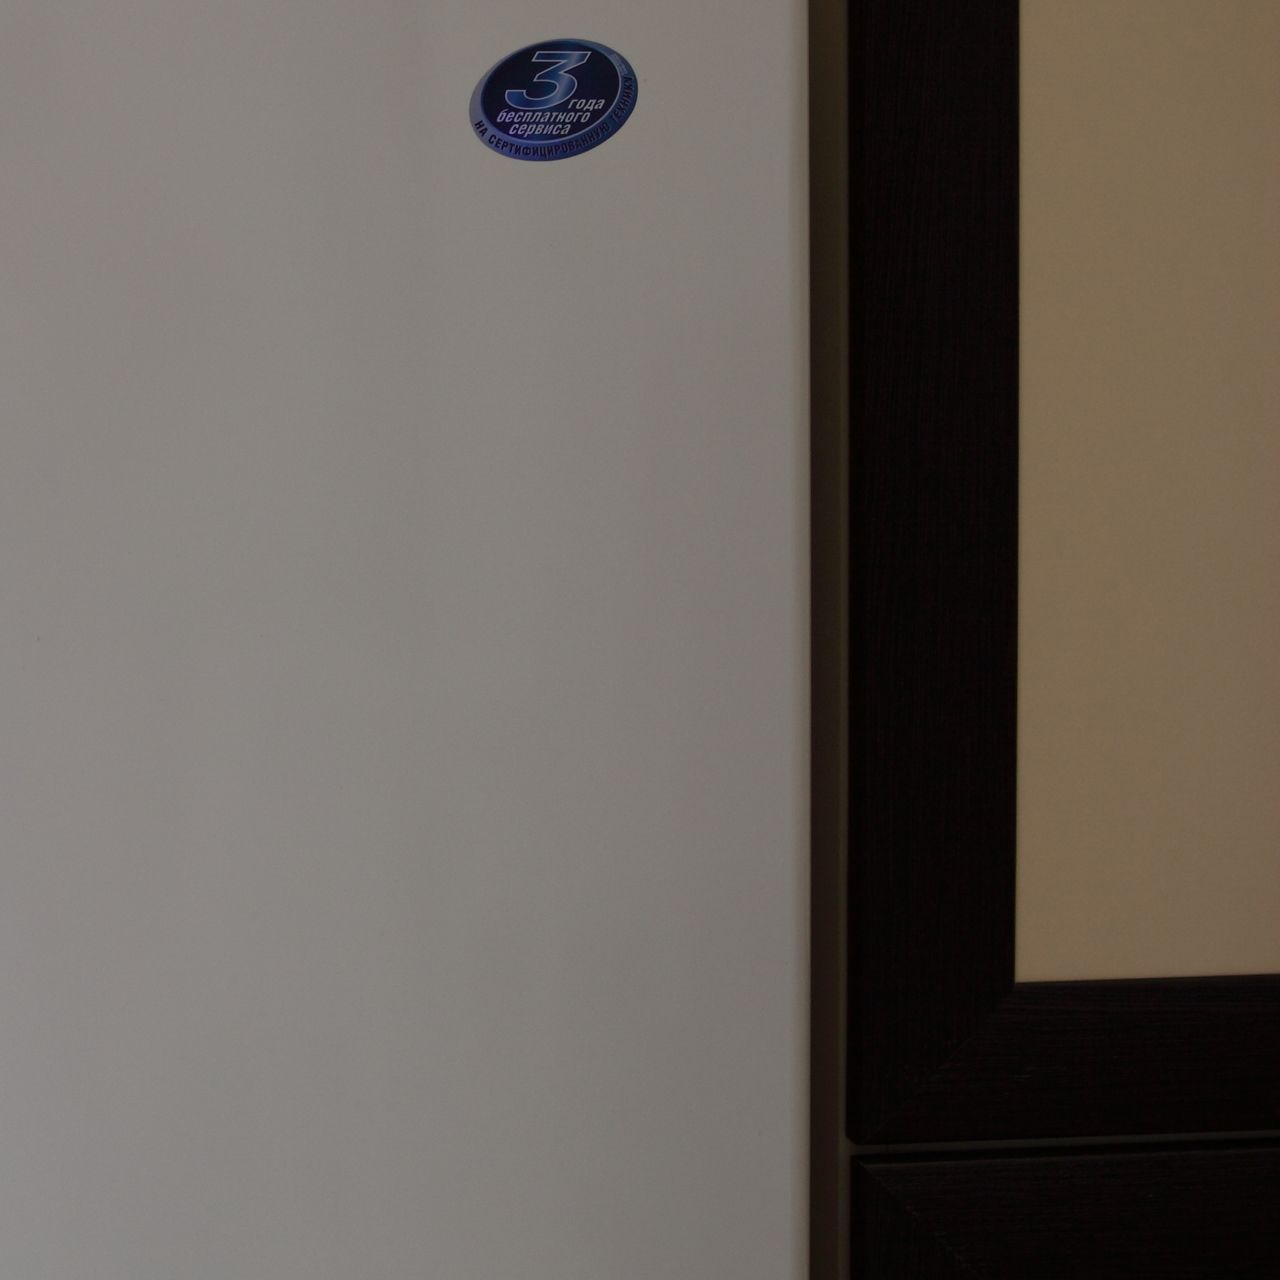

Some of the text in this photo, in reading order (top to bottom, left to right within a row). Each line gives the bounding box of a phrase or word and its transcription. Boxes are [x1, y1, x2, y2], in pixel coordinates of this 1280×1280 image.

[505, 51, 592, 110] 3
[567, 98, 606, 112] года
[496, 109, 591, 124] бесплатного
[474, 120, 487, 138] НА
[509, 122, 571, 138] сервиса
